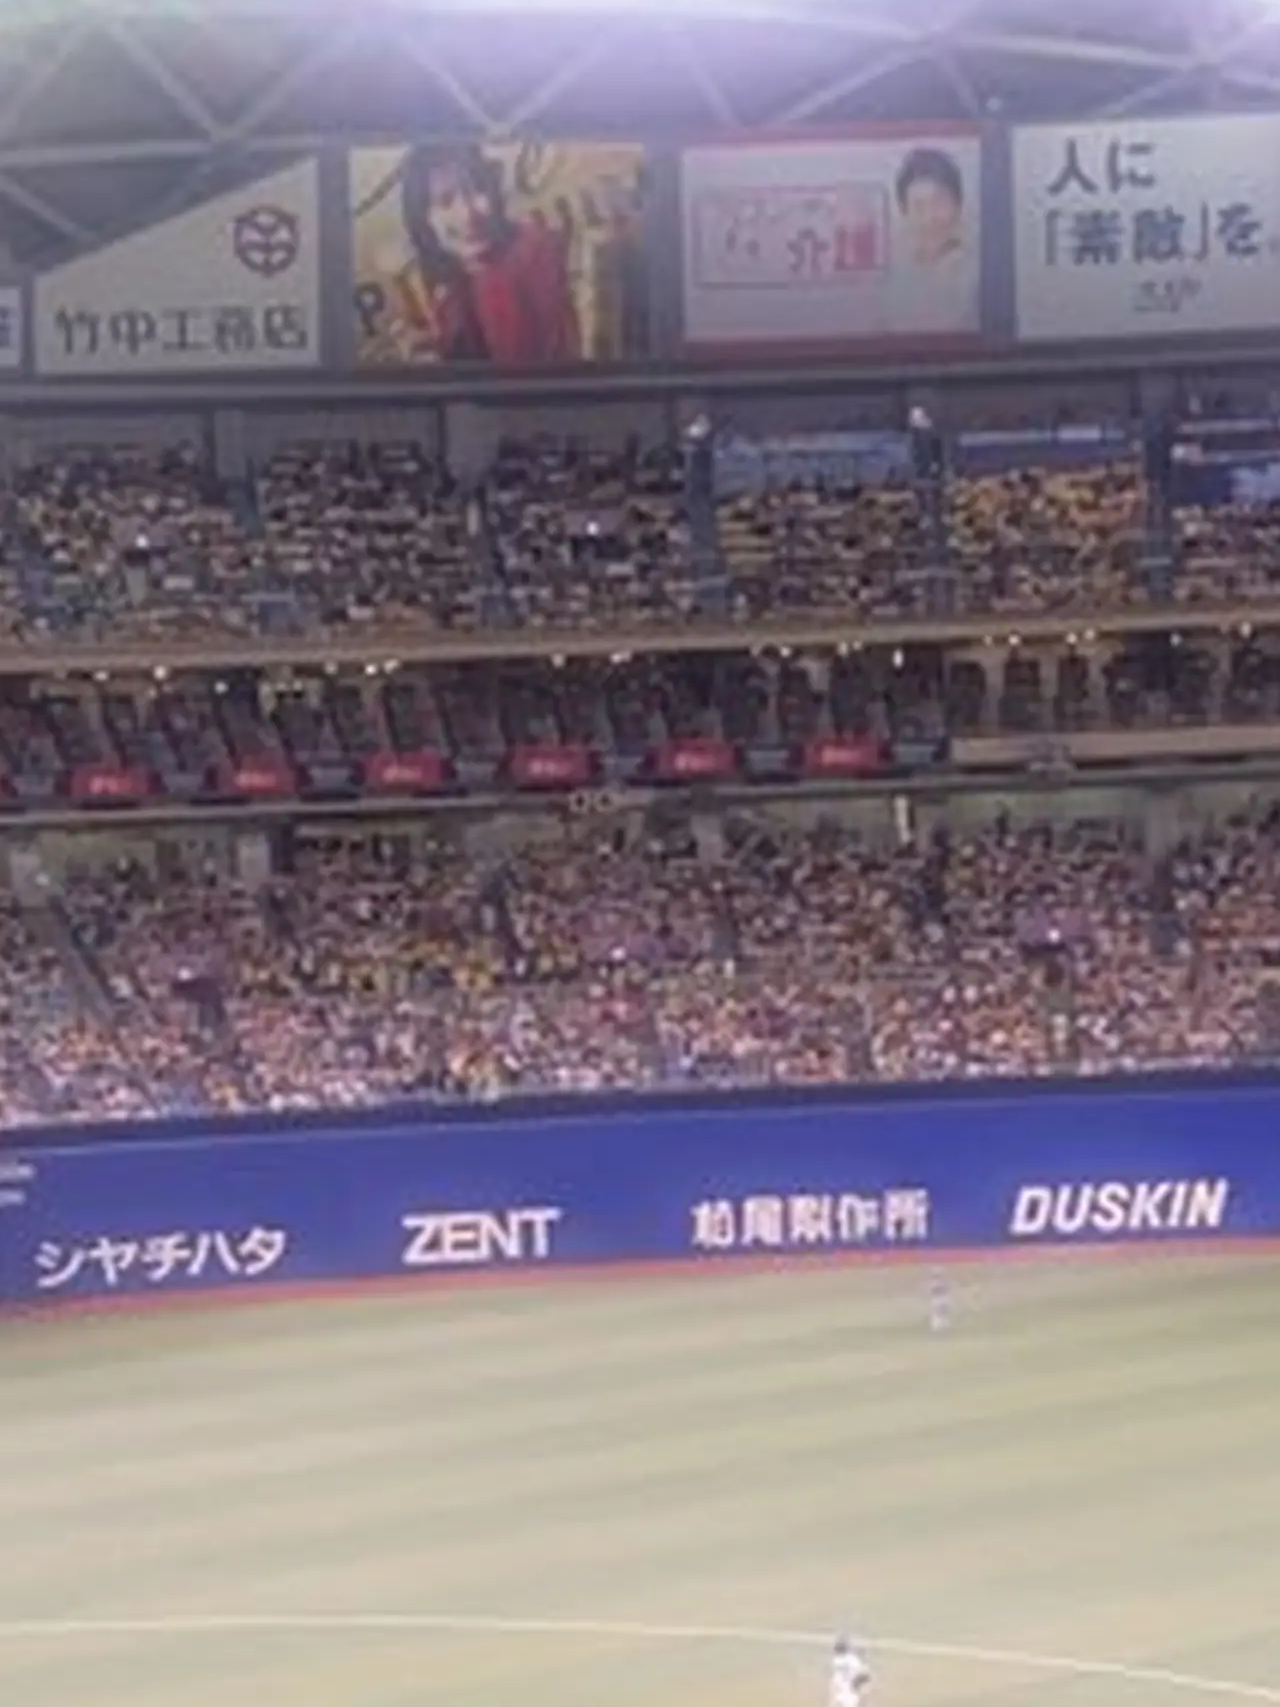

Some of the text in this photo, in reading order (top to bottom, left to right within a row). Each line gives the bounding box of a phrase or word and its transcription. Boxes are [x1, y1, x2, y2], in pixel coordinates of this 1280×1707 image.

[1048, 138, 1155, 195] 人に
[402, 1206, 562, 1265] ZENT
[1009, 1177, 1230, 1237] DUSKIN
